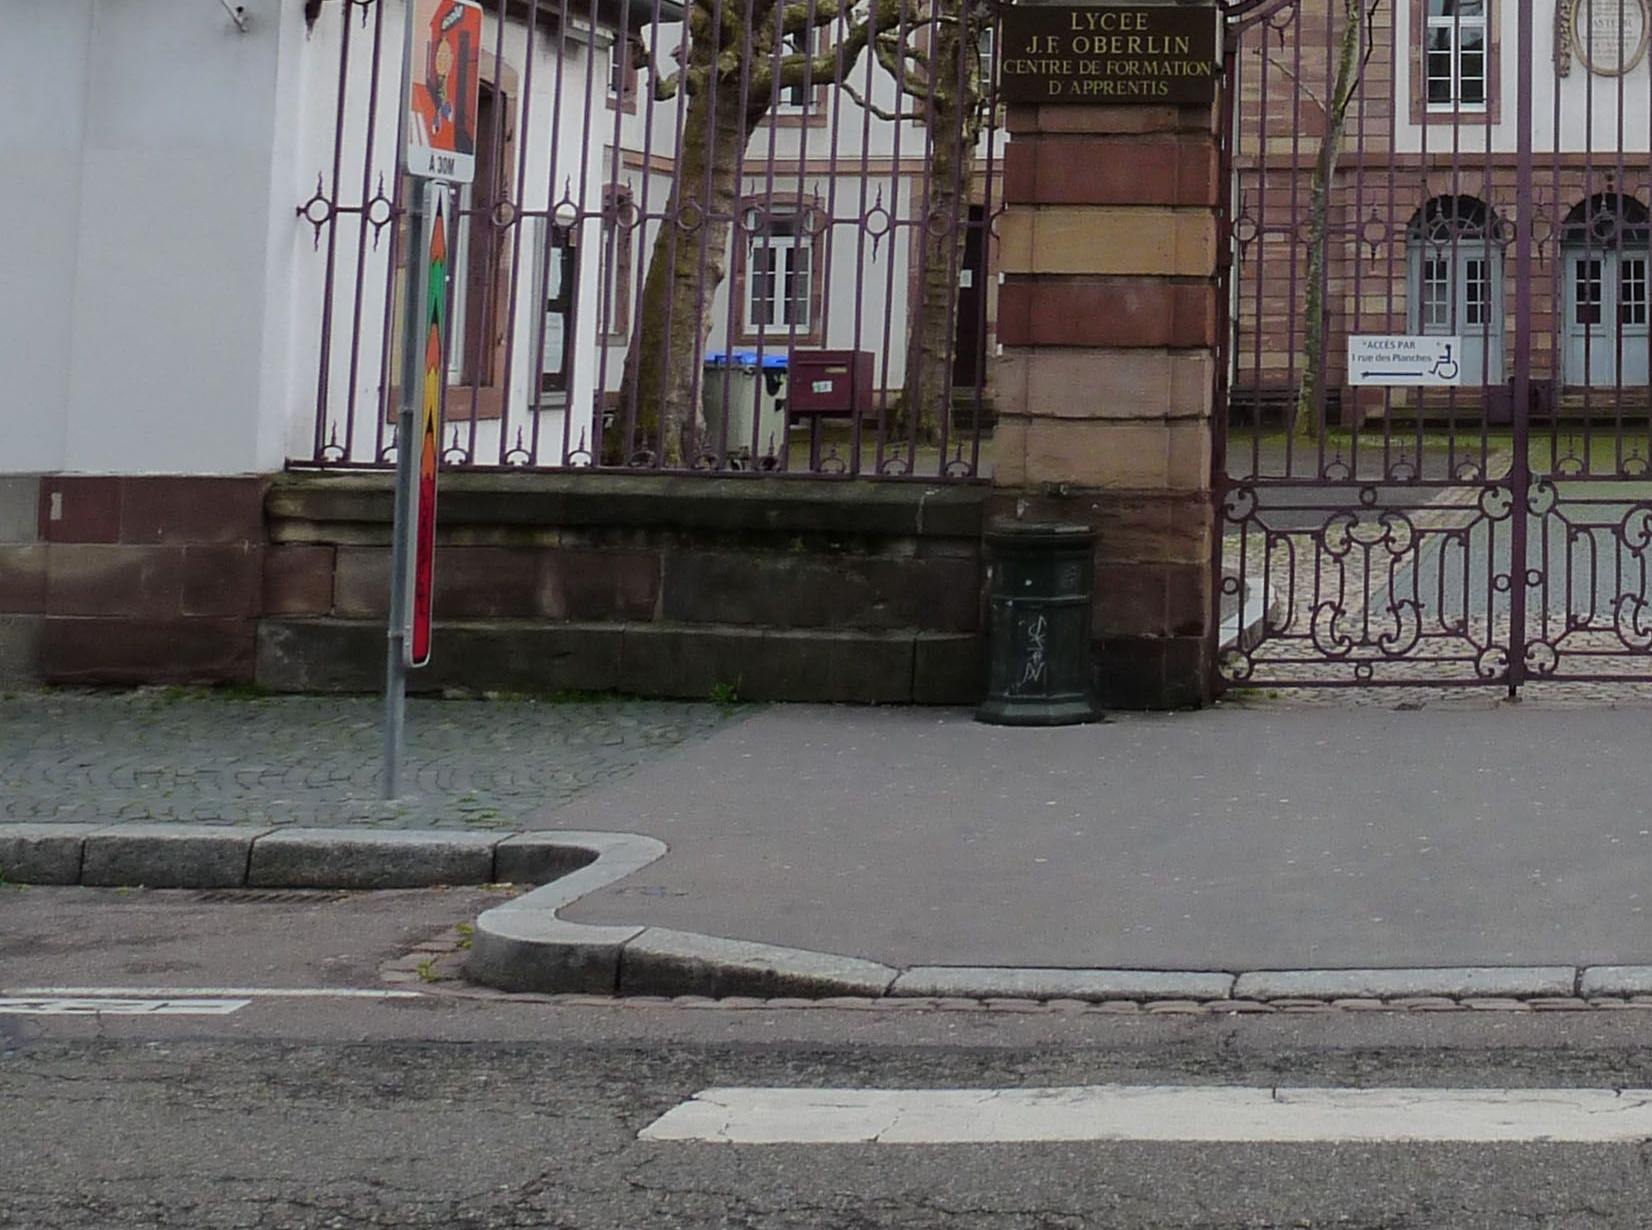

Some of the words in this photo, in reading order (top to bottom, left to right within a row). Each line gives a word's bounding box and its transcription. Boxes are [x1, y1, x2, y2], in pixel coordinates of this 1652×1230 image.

[1070, 12, 1149, 31] LYCEE
[1072, 36, 1189, 55] OBERLIN
[1003, 59, 1072, 75] CENTRE
[1079, 60, 1101, 75] DE
[1107, 60, 1212, 76] FORMATION
[1398, 341, 1415, 349] PAR
[1375, 354, 1391, 362] des
[1392, 354, 1432, 362] Planches
